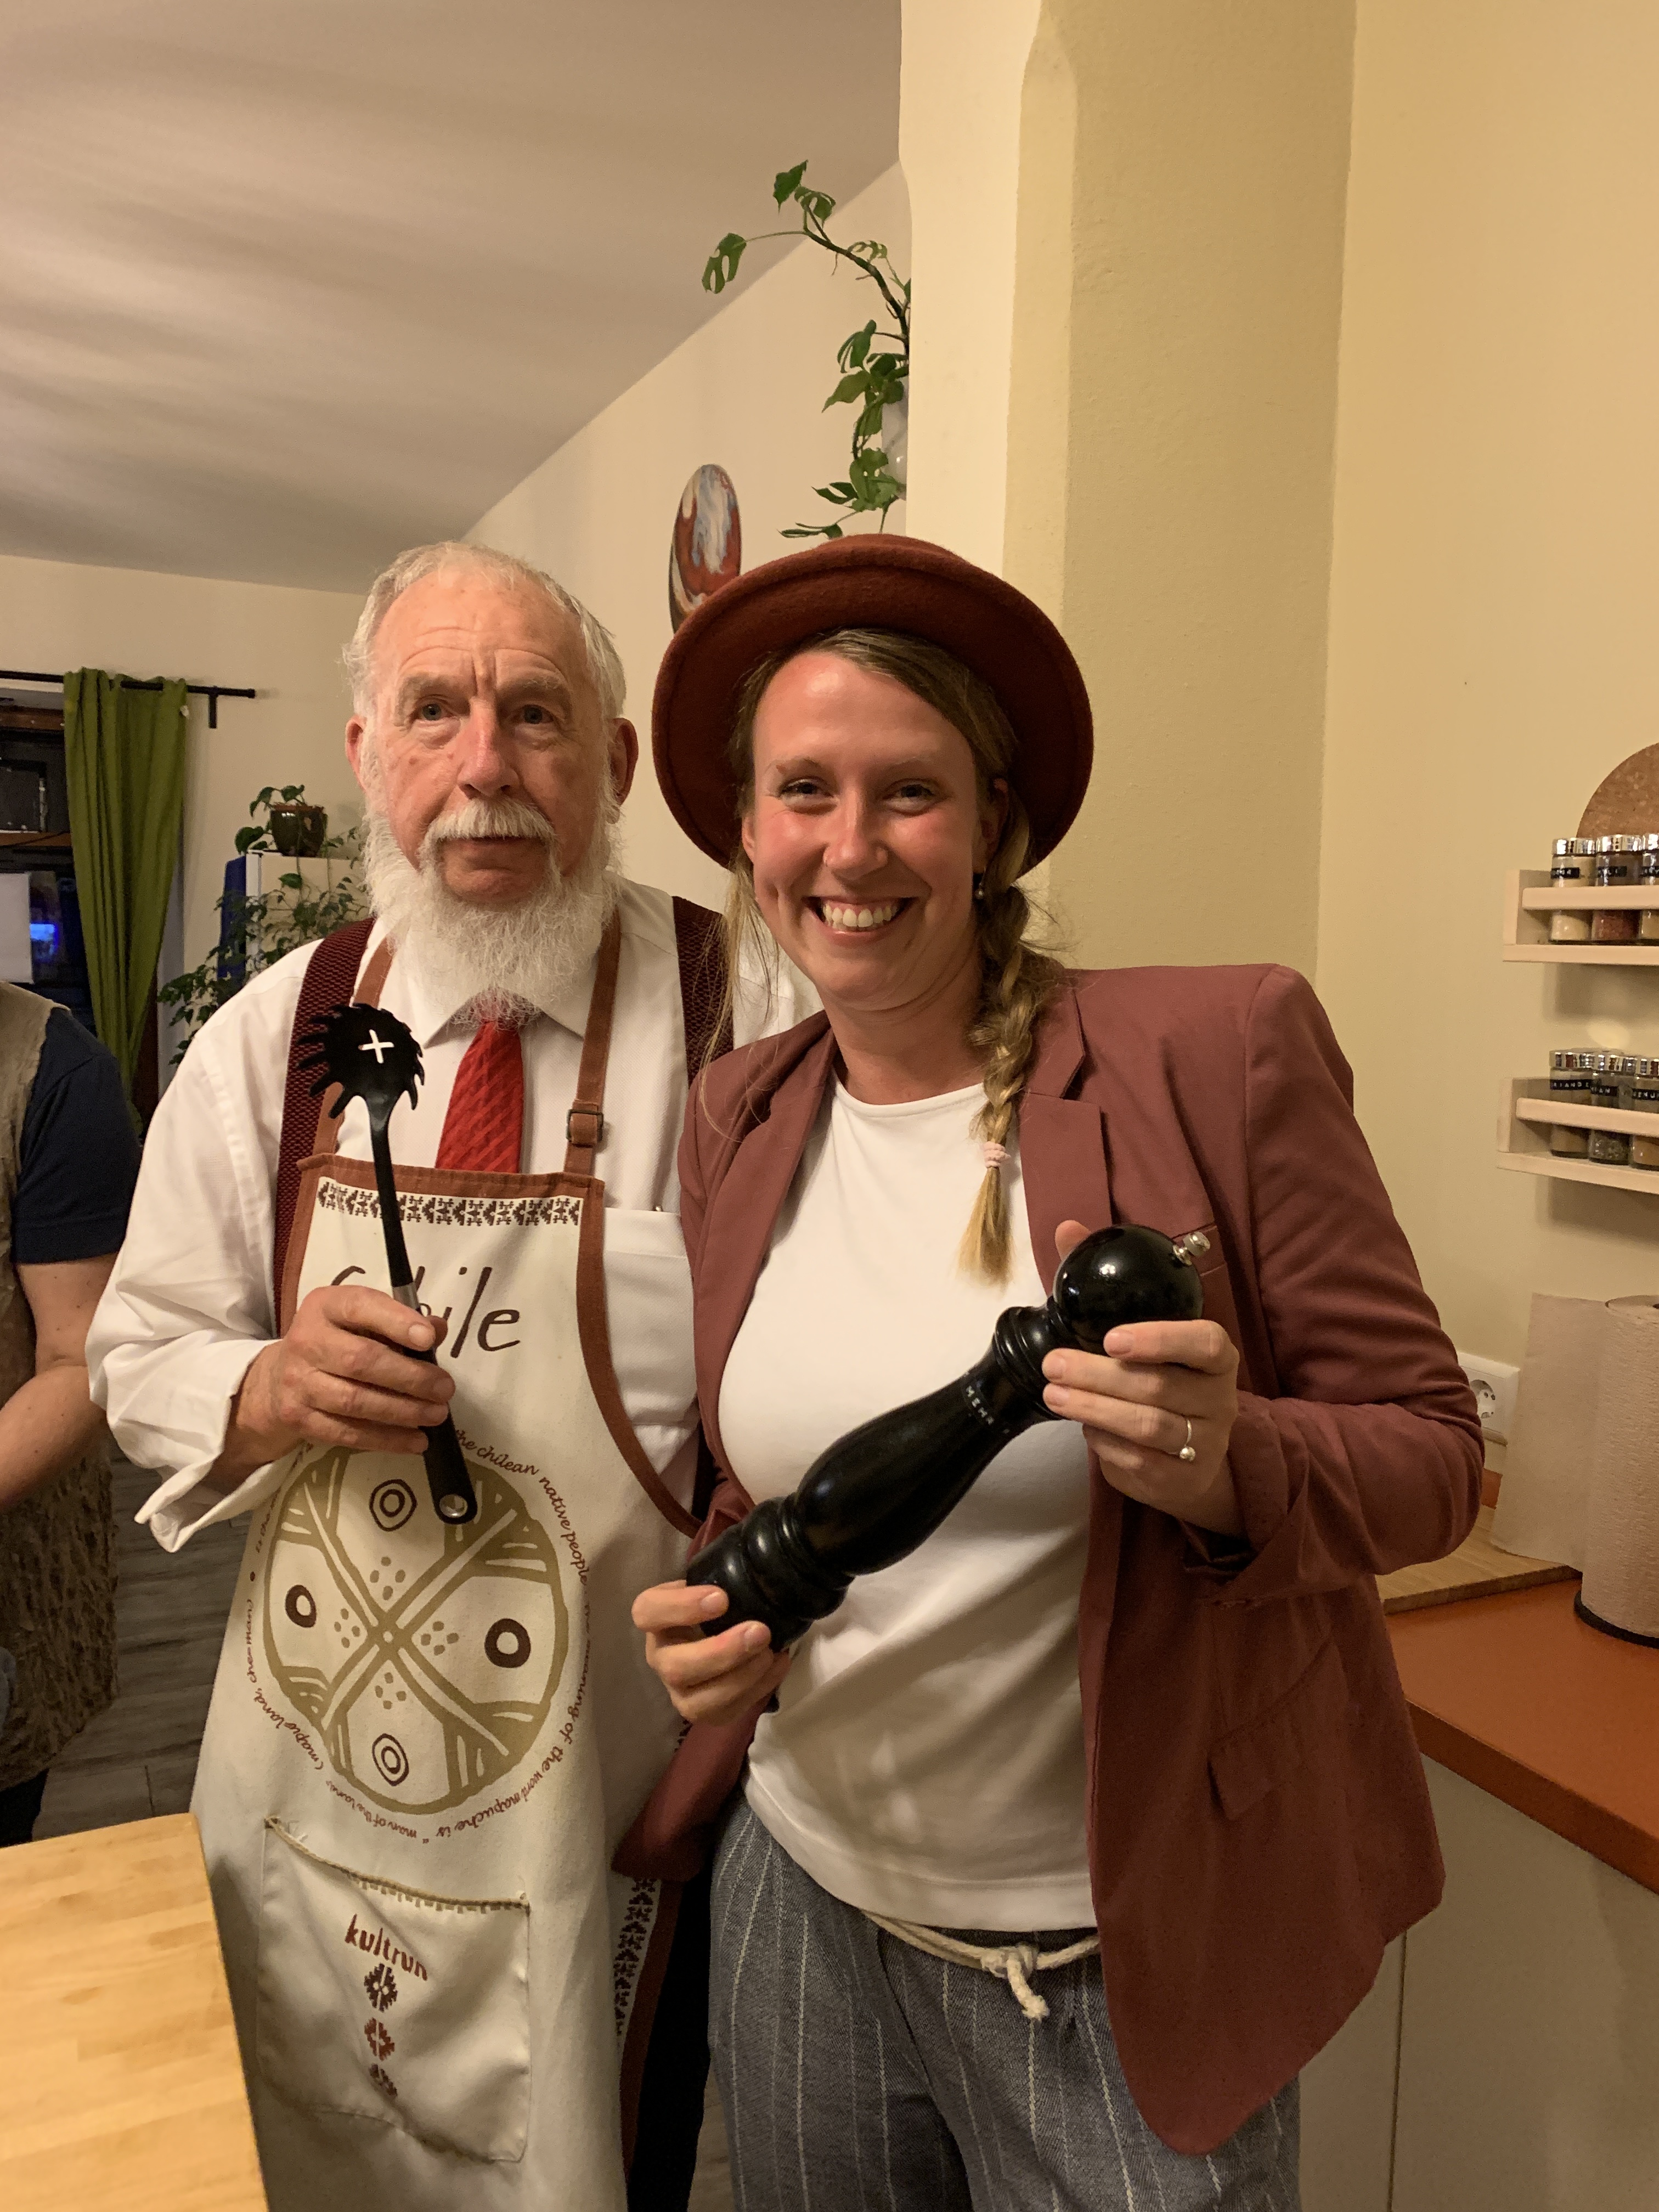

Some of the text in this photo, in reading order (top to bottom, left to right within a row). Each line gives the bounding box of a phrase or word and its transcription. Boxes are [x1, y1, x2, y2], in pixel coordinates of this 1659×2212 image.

[476, 1445, 540, 1475] chilean
[538, 1476, 572, 1531] native
[560, 1530, 590, 1586] people
[558, 1722, 573, 1745] of
[541, 1746, 563, 1773] the
[521, 1770, 543, 1802] word
[357, 1803, 371, 1822] the
[373, 1813, 386, 1827] of
[454, 1792, 521, 1830] mapuche
[436, 1825, 451, 1838] is
[345, 1913, 428, 1982] kultrun
